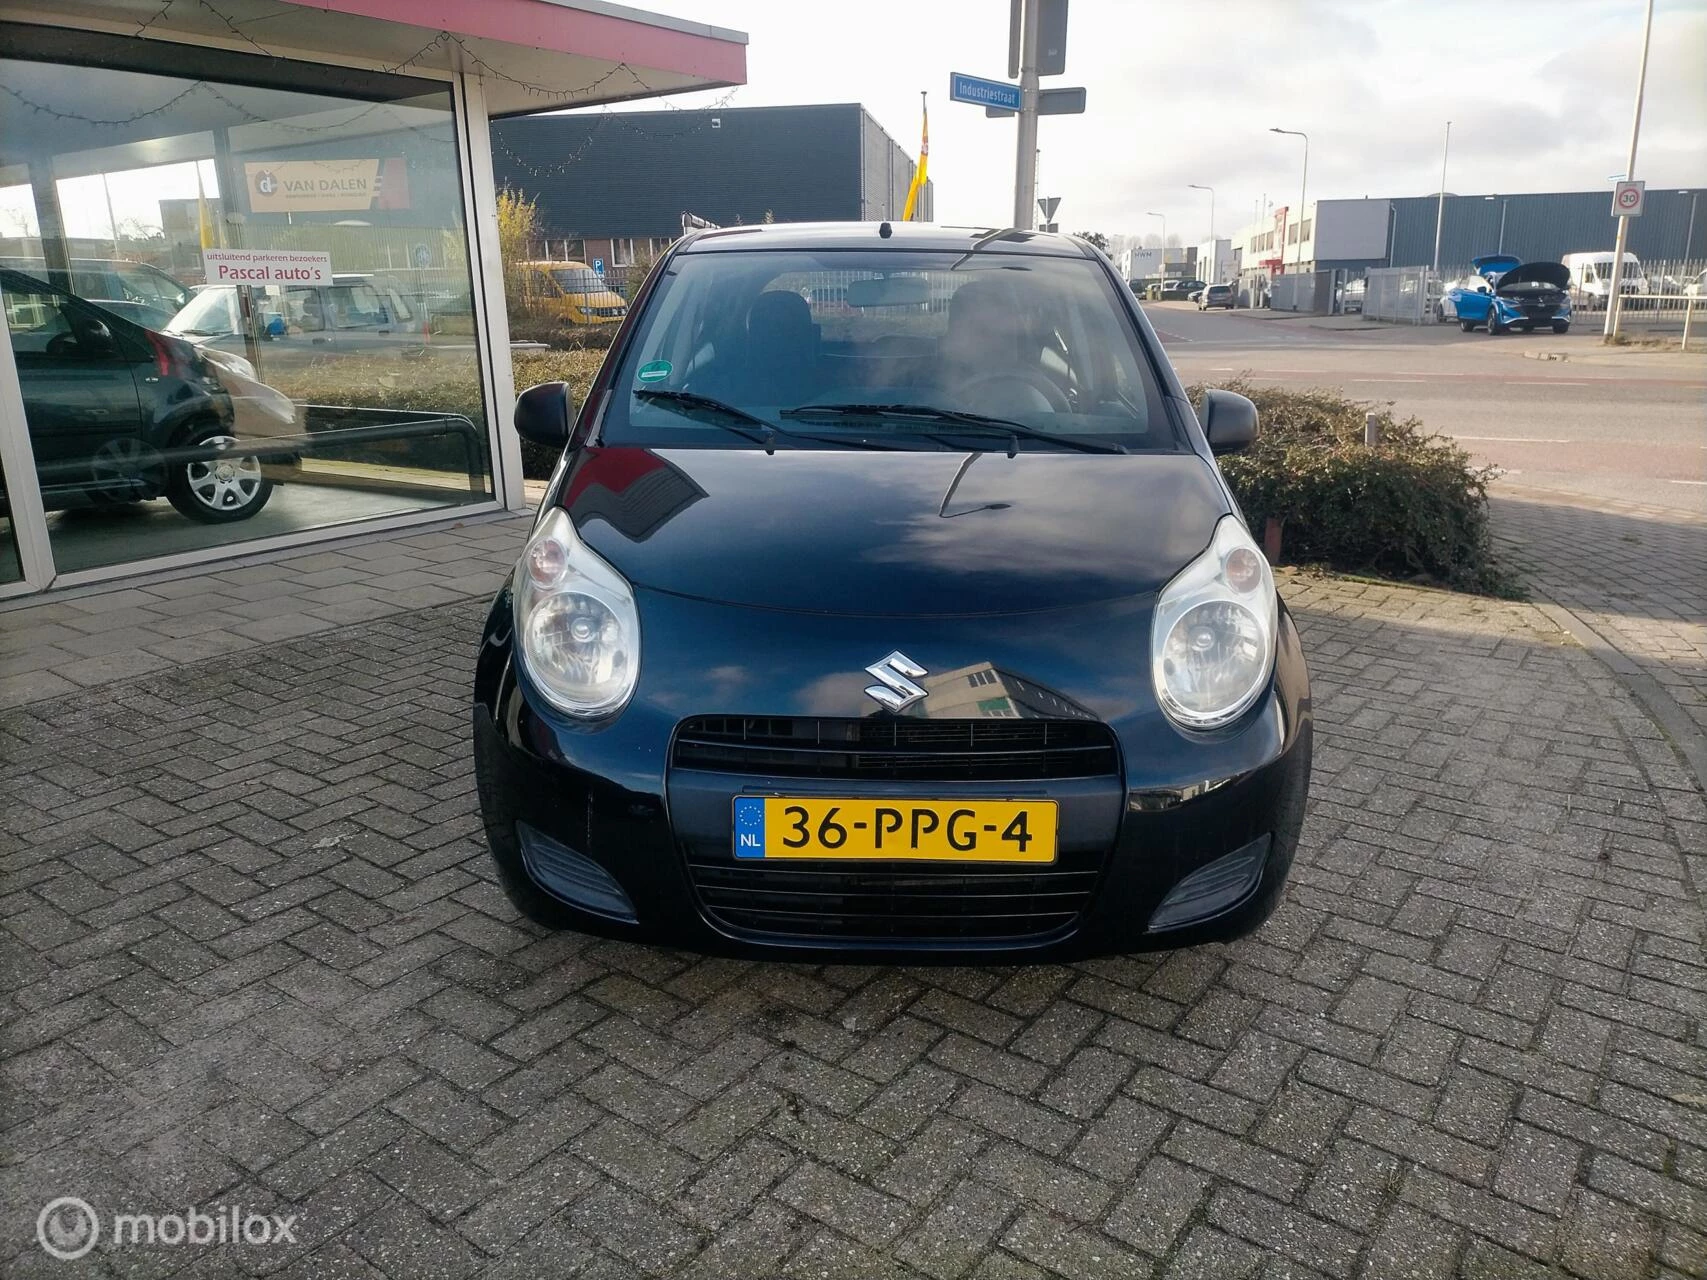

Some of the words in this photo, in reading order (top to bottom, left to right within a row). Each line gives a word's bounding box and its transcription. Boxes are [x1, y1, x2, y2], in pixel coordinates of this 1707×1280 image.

[959, 81, 1016, 104] Industriestraat
[283, 180, 315, 192] VAN
[319, 178, 367, 191] DALEN
[207, 252, 251, 261] uitsluitend
[252, 253, 288, 263] parkeren
[289, 254, 328, 263] bezoekers
[218, 265, 270, 279] Pascal
[274, 266, 322, 280] auto's
[782, 806, 1033, 853] 36-PPG-4
[740, 833, 761, 848] NL
